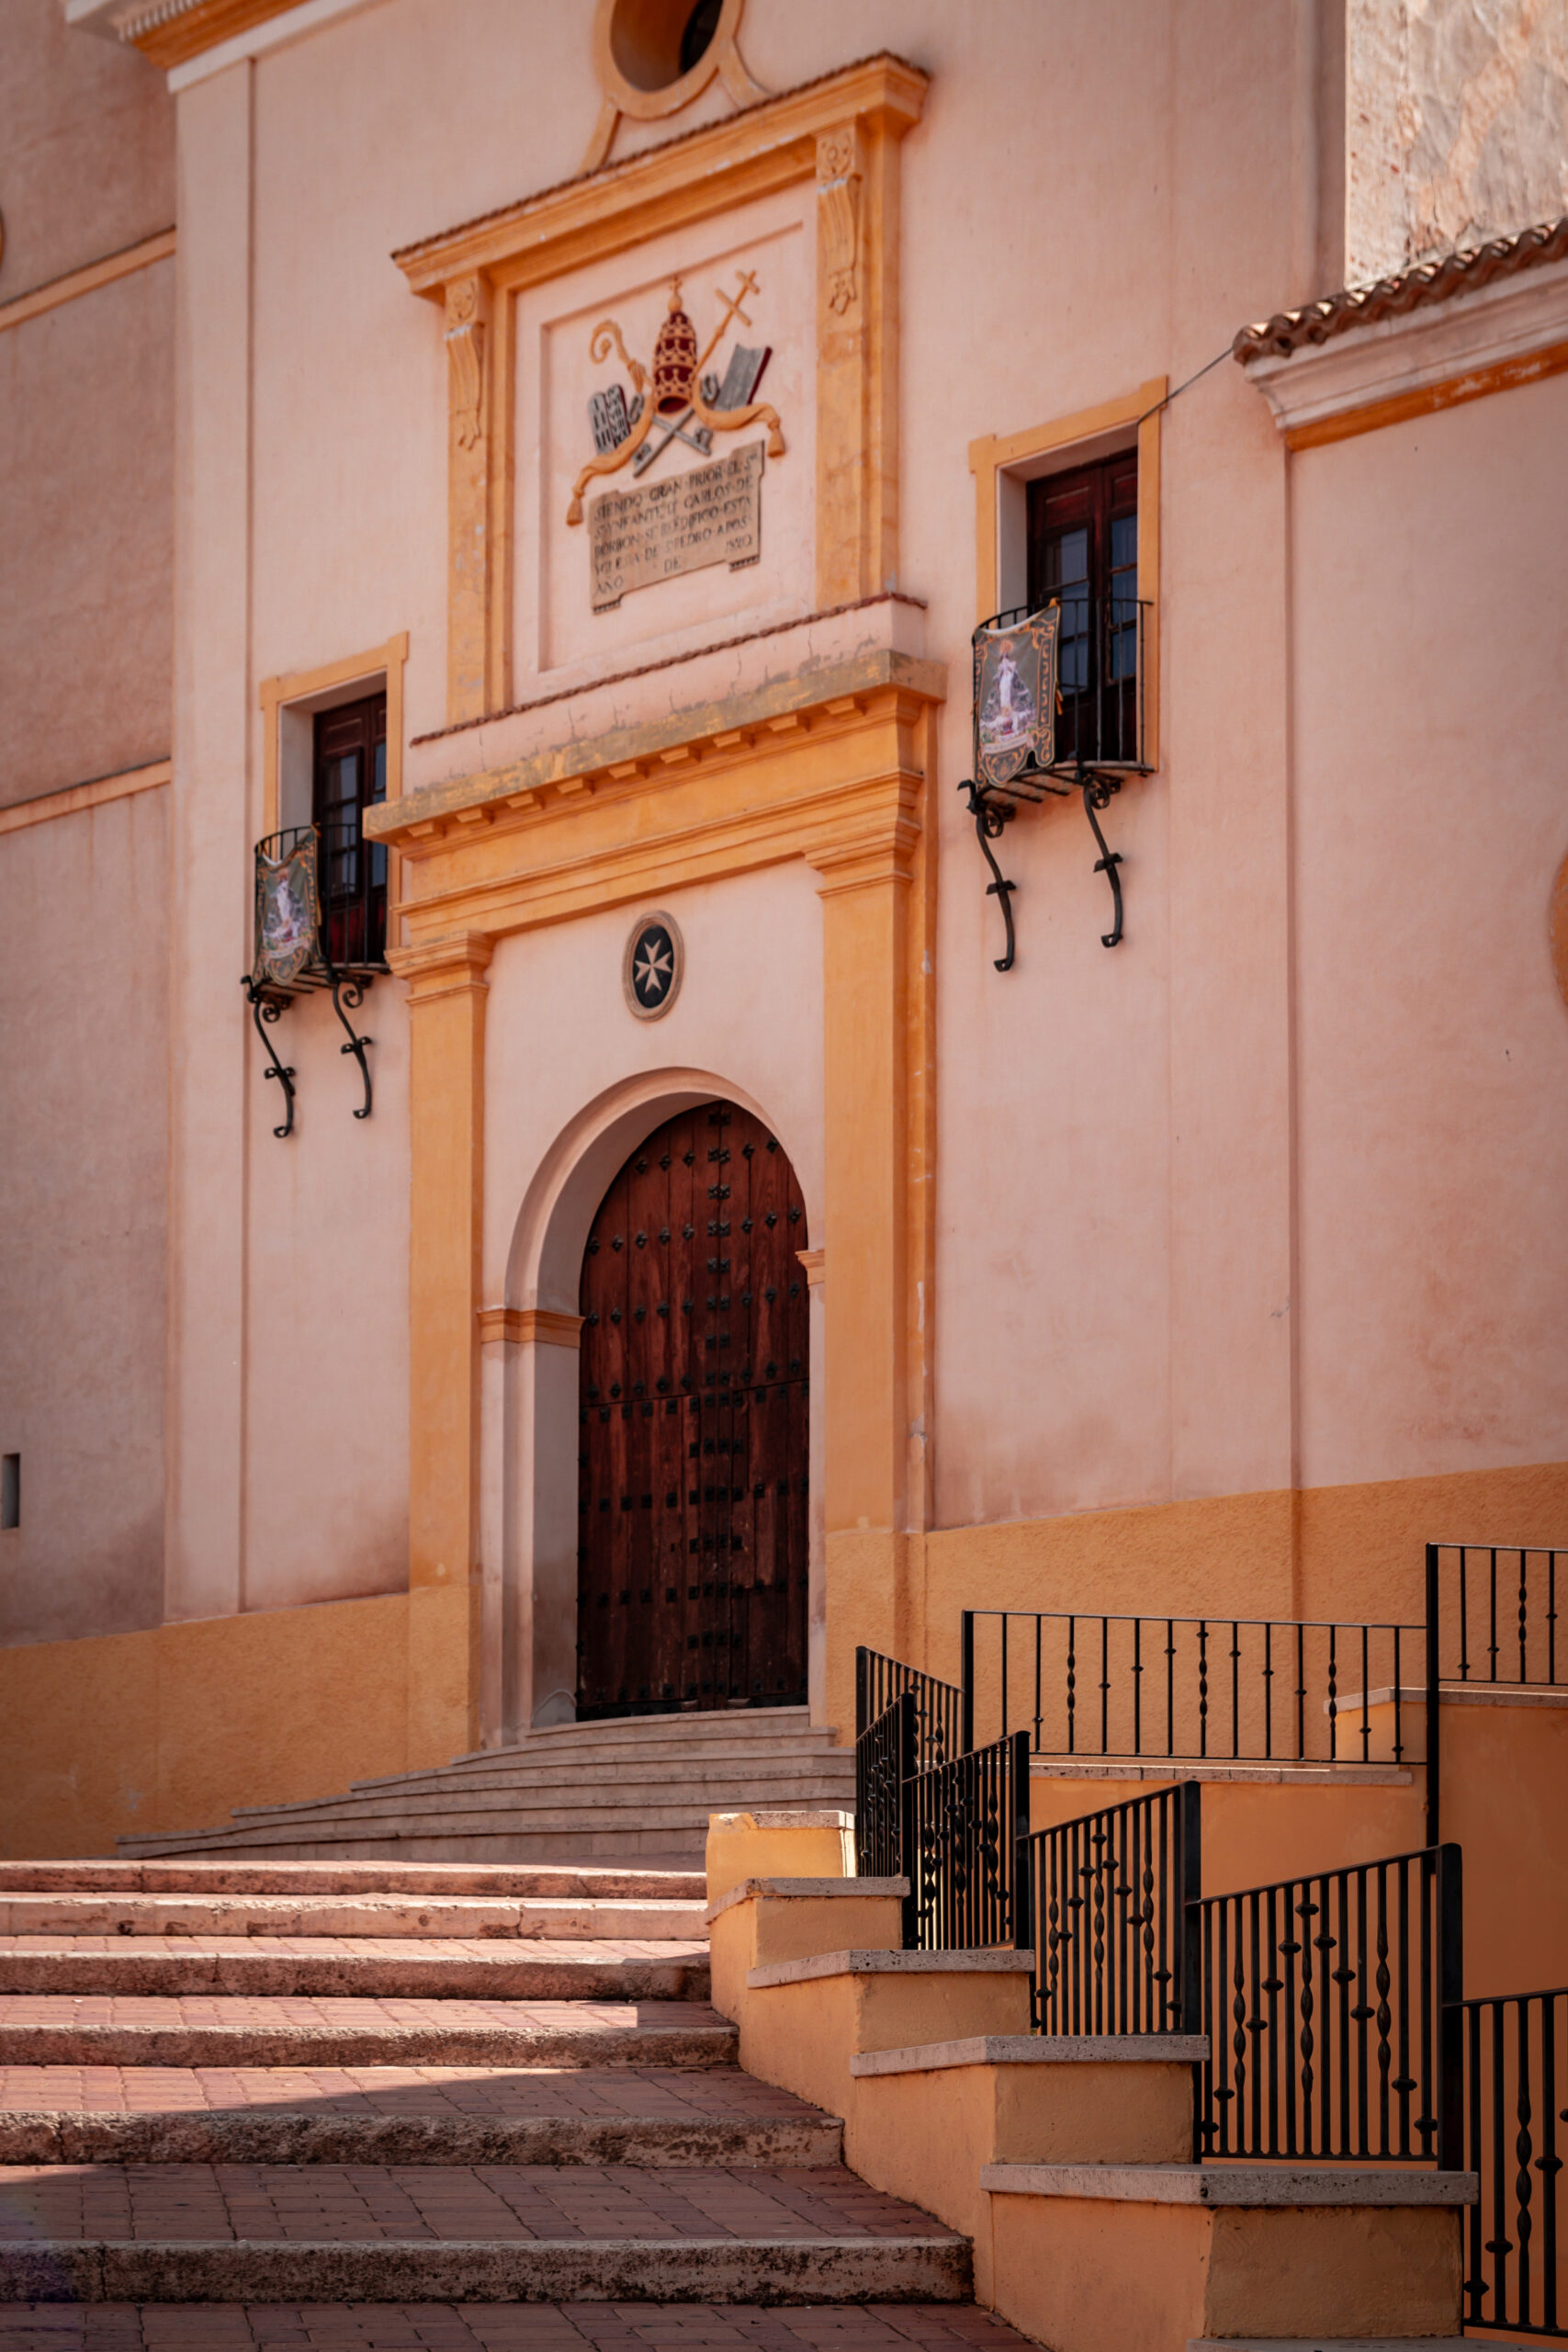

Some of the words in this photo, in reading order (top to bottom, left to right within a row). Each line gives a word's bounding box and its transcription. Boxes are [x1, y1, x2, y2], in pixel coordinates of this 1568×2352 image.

[649, 479, 682, 503] GRAN
[689, 464, 723, 489] PRIOR
[683, 481, 731, 510] CARLOS
